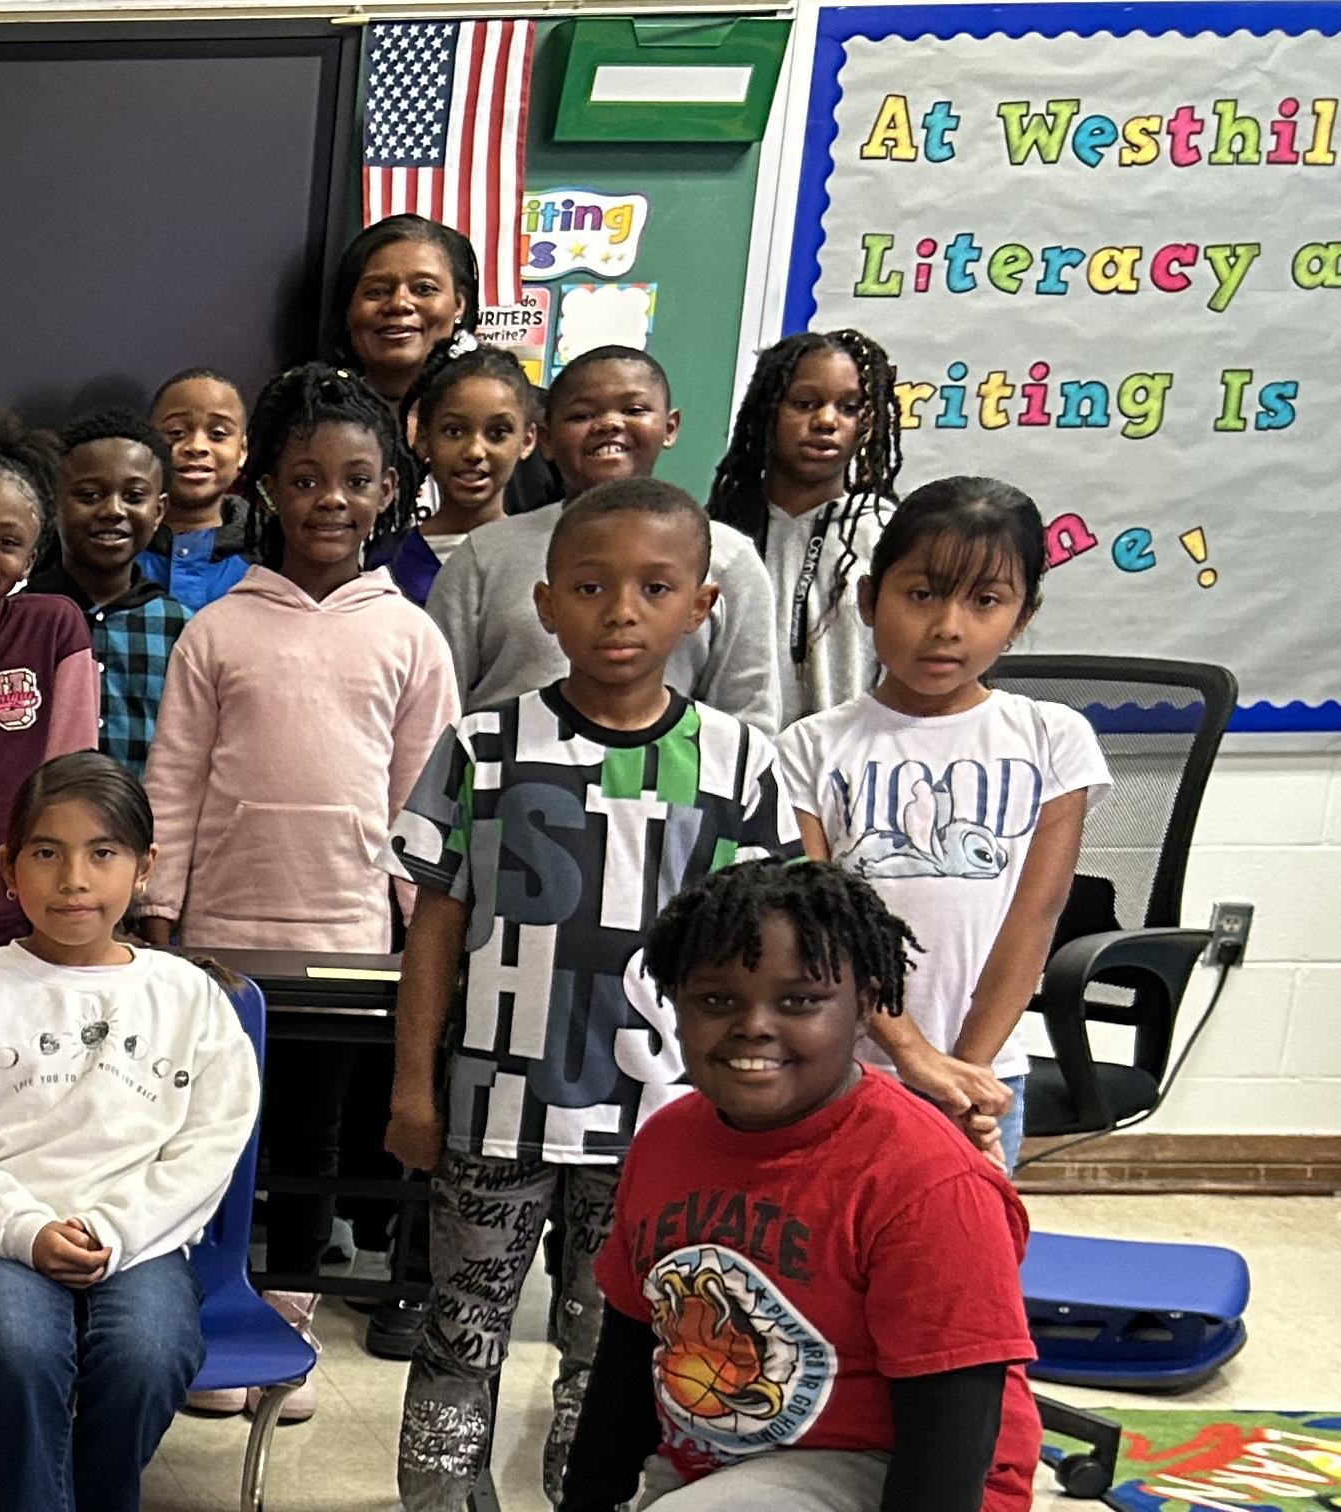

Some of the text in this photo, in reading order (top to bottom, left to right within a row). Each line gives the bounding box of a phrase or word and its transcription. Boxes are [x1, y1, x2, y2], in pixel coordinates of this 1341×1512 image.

[860, 94, 961, 162] At
[522, 198, 634, 244] iting
[854, 233, 1261, 312] Literacy
[520, 295, 536, 308] do
[482, 328, 528, 342] write?
[889, 360, 1299, 440] riting Is
[829, 758, 1043, 838] MOOD
[40, 1074, 59, 1084] YOU
[65, 1073, 77, 1084] TO
[634, 1188, 813, 1285] LEVATE
[765, 1302, 806, 1340] PLAY
[786, 1393, 813, 1417] GO
[756, 1412, 797, 1444] HOM
